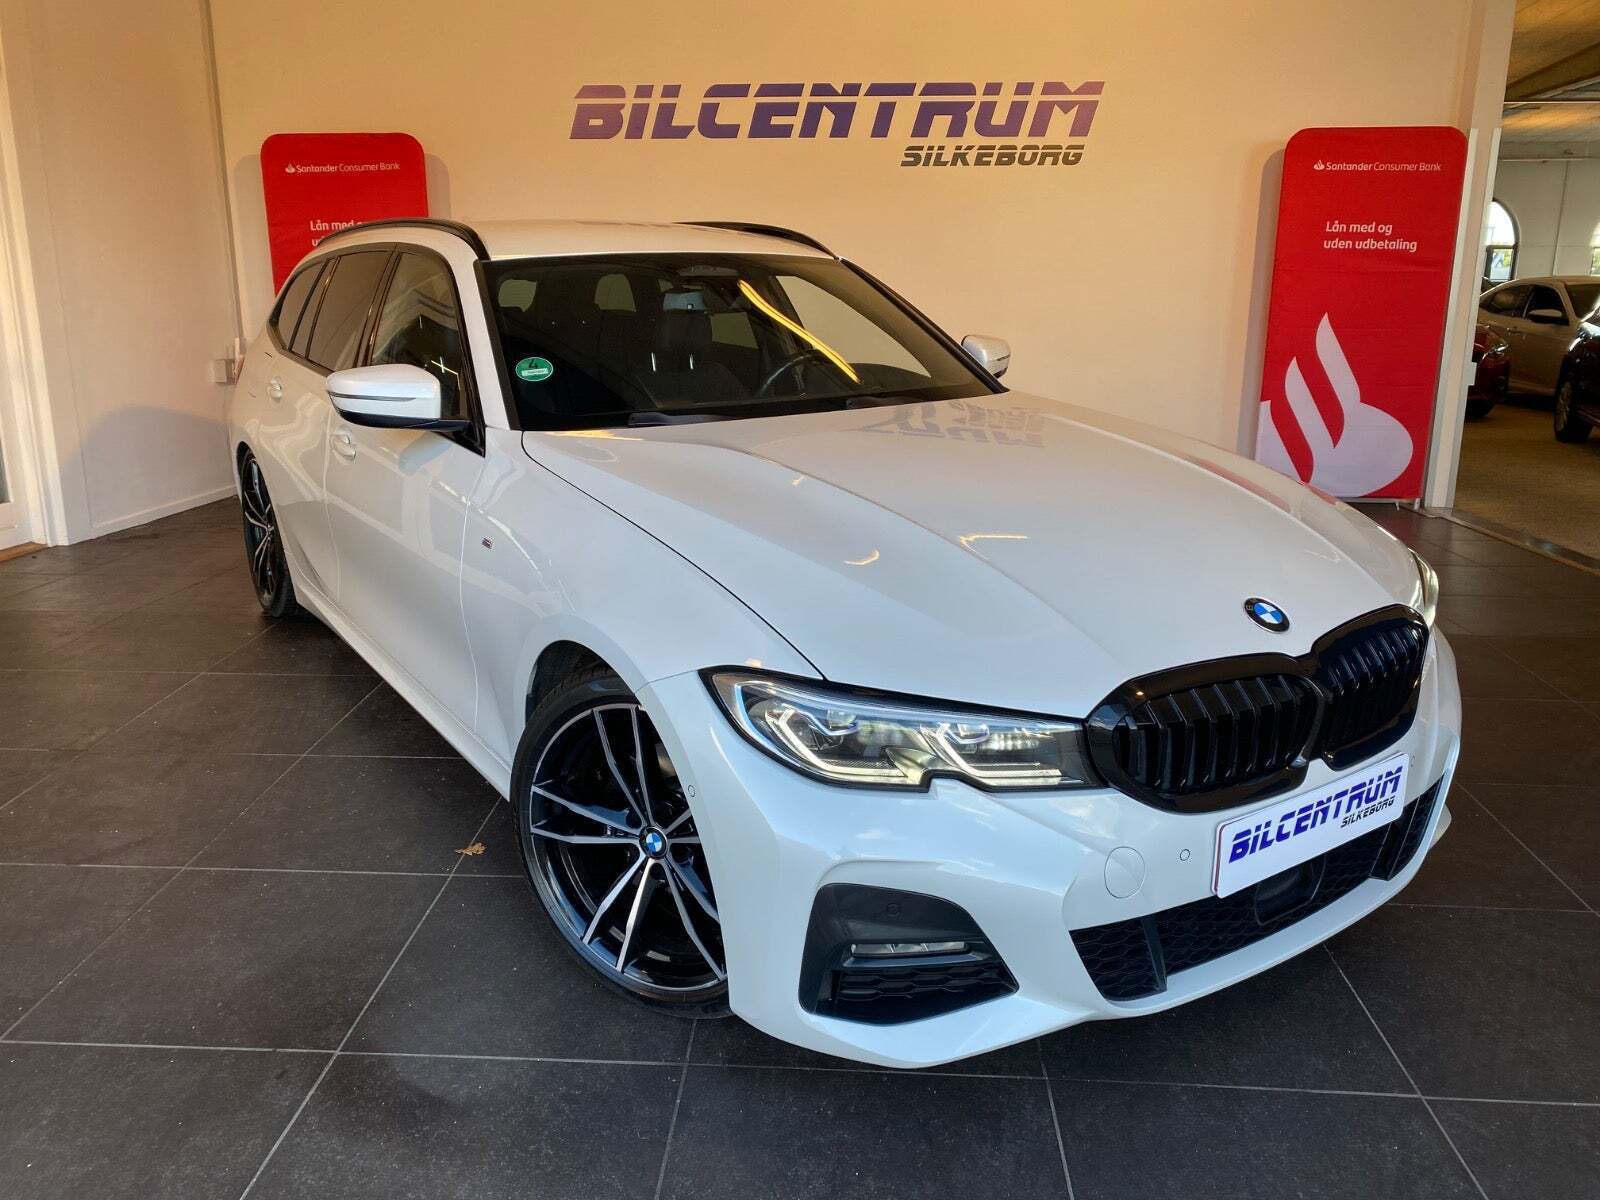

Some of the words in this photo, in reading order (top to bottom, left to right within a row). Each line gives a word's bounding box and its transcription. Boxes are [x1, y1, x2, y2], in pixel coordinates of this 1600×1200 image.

[569, 81, 1105, 140] BILCENTRUM
[899, 143, 1084, 167] SILKEBORG
[296, 164, 338, 173] Santander
[339, 163, 379, 172] Consumer
[380, 162, 400, 171] Bank
[1326, 162, 1372, 171] Santander
[1373, 162, 1417, 171] Consumer
[1419, 162, 1441, 171] Bank
[310, 219, 329, 231] Lån
[1326, 220, 1346, 232] Lån
[1349, 221, 1375, 233] med
[1378, 224, 1392, 236] og
[1323, 238, 1352, 249] uden
[1355, 239, 1417, 252] udbetaling
[1229, 766, 1403, 864] BILCENTRUM
[1340, 796, 1396, 828] SILKEBORG
